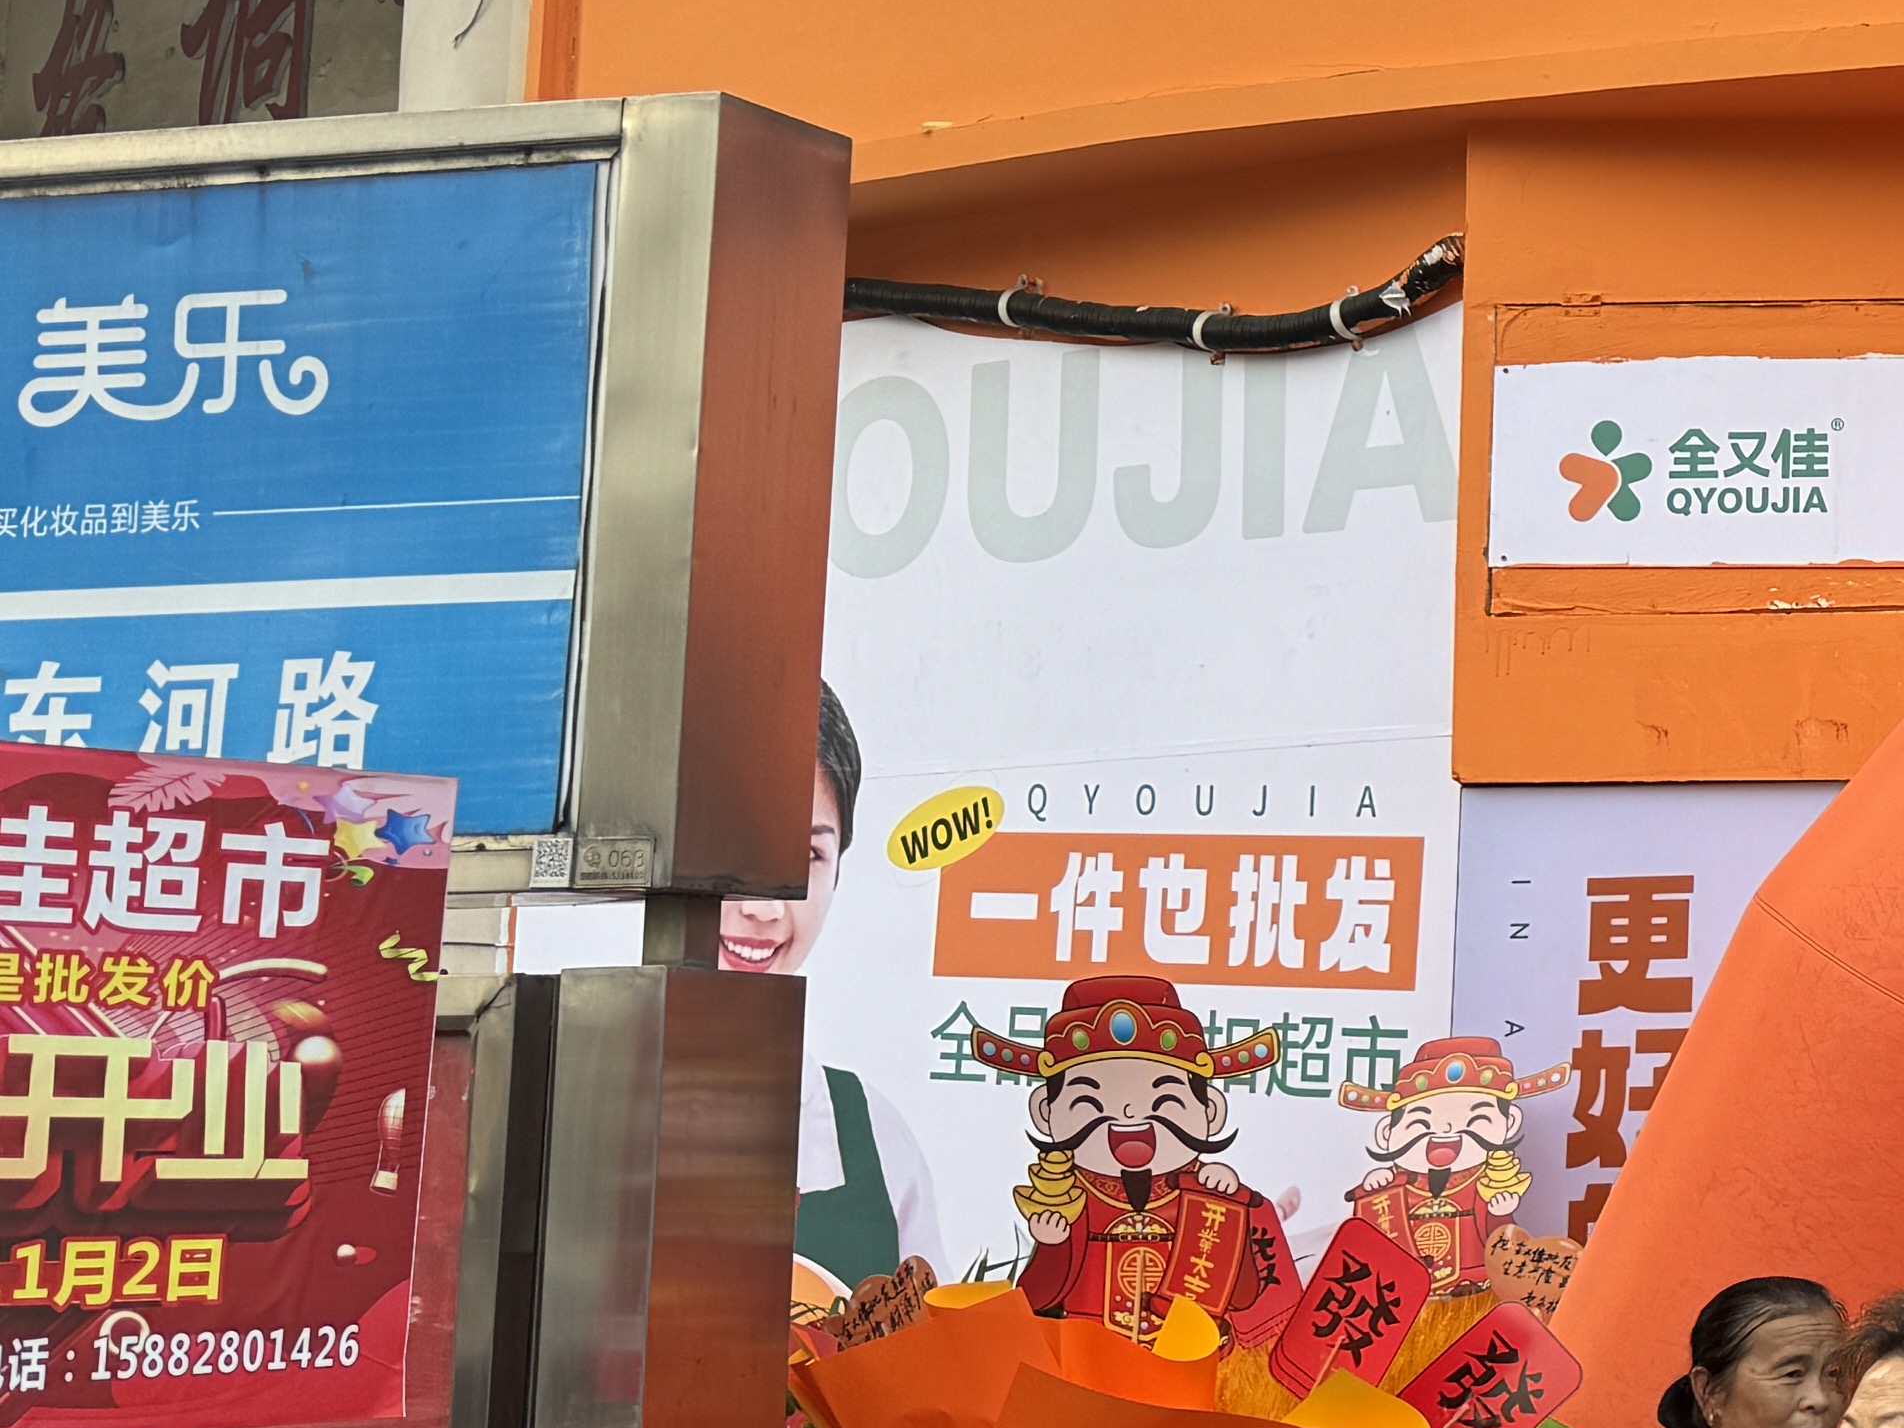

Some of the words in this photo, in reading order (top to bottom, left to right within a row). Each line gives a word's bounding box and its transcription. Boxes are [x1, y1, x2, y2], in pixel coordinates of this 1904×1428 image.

[18, 288, 329, 427] 美乐
[1668, 428, 1830, 480] 全又佳
[1666, 485, 1829, 517] QYOUJIA
[4, 651, 380, 770] 东河路
[900, 796, 994, 865] WOW!
[1027, 783, 1378, 822] QYOUJIA
[970, 852, 1396, 973] 一件也批发
[12, 1238, 226, 1302] 1月2日
[0, 1324, 360, 1392] 话：15882801426
